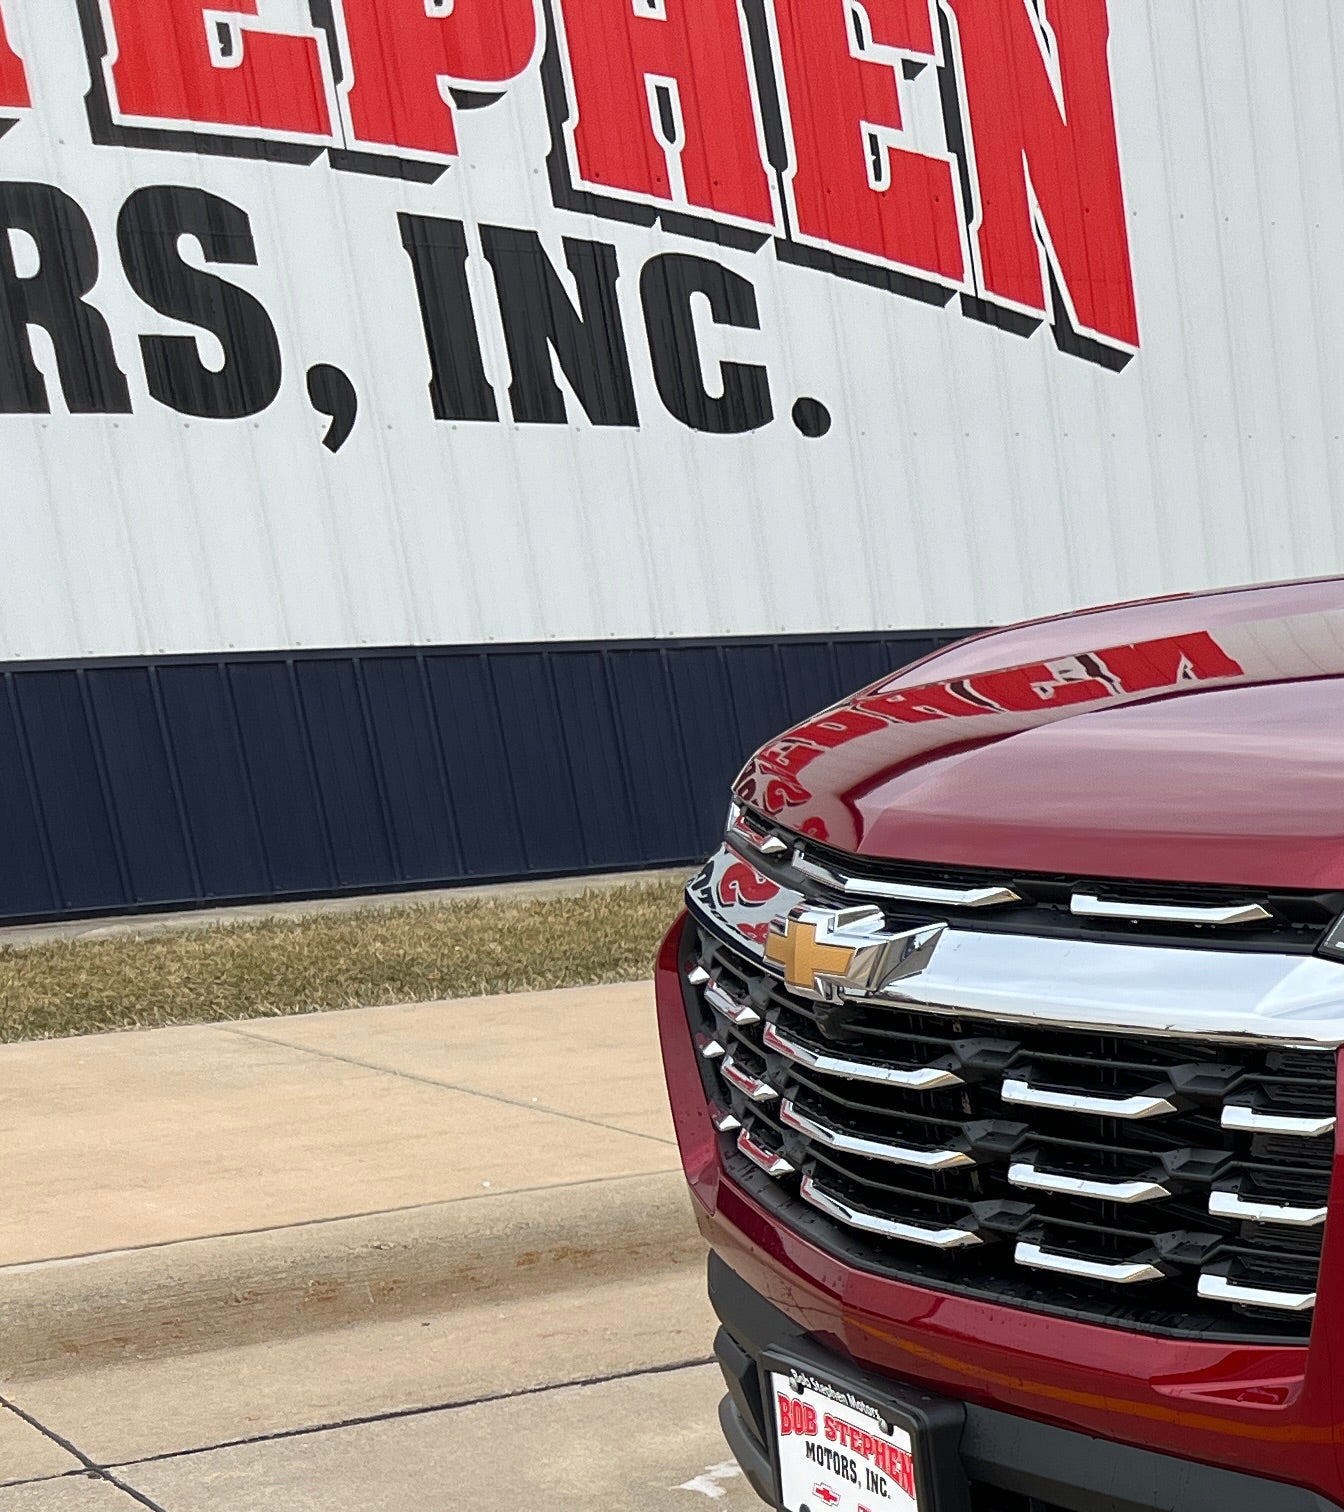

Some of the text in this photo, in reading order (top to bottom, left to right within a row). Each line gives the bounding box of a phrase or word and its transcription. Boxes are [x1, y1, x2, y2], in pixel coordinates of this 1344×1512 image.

[0, 0, 1139, 372] EPHEN
[397, 210, 832, 438] INC.
[777, 1391, 916, 1501] BOB STEPHEN
[810, 1377, 849, 1406] Stephen
[846, 1392, 882, 1419] Motors
[805, 1440, 892, 1500] MOTORS, INC.
